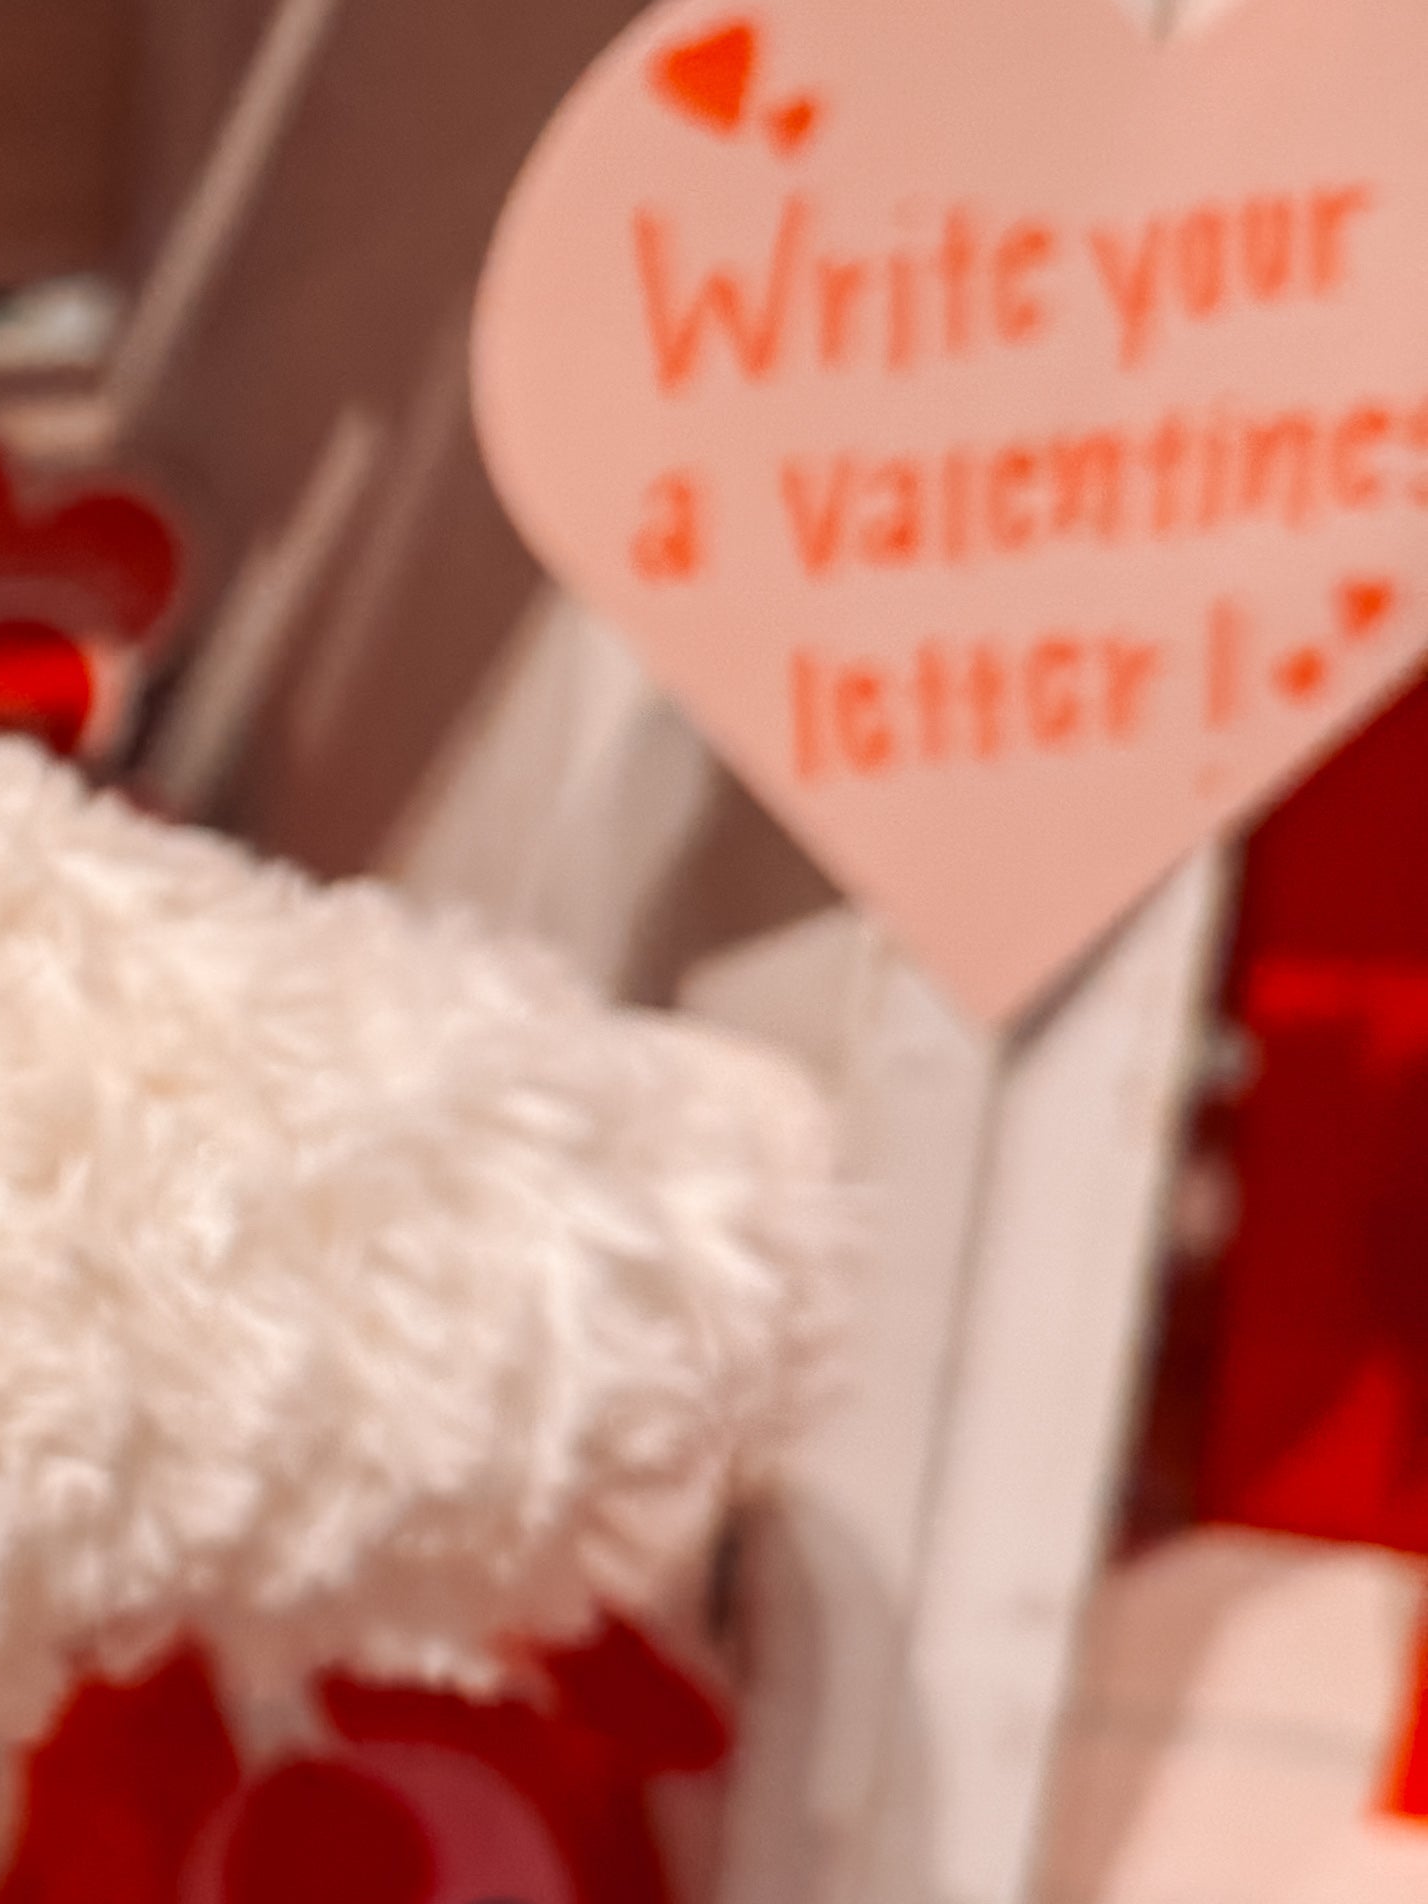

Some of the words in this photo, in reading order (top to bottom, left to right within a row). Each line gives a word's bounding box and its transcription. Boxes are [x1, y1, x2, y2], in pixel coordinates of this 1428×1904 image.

[632, 186, 1052, 394] Write
[1086, 182, 1372, 373] your
[629, 466, 700, 584] a
